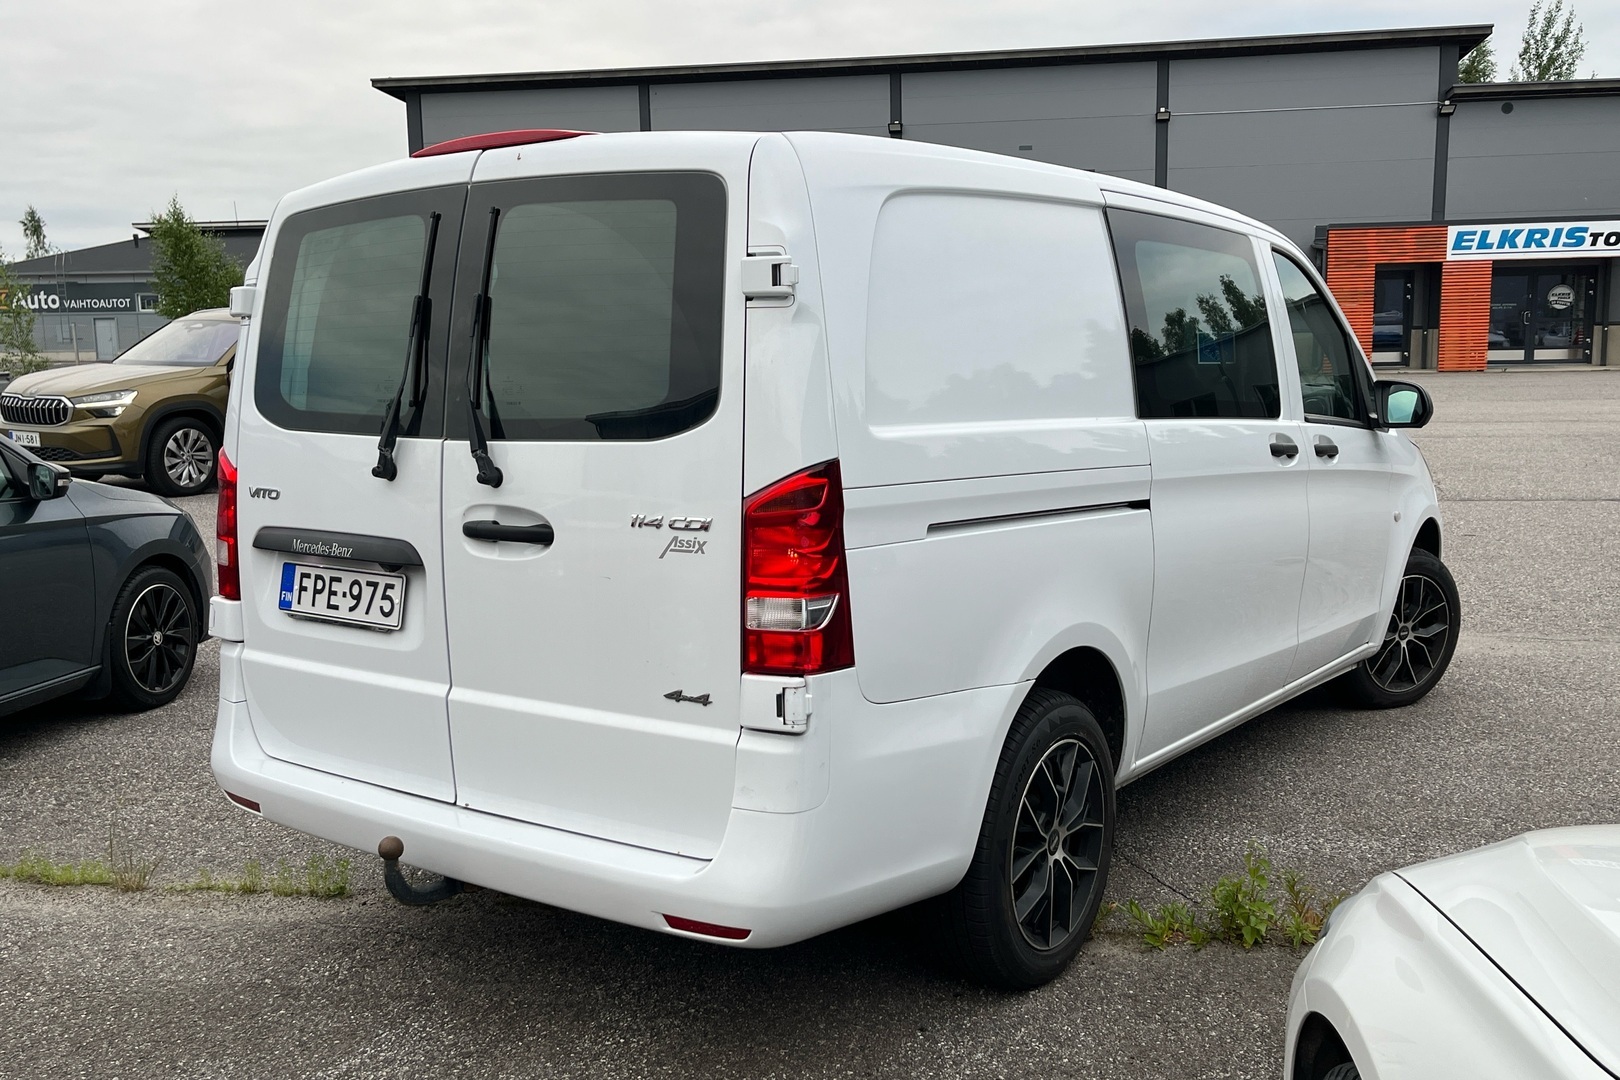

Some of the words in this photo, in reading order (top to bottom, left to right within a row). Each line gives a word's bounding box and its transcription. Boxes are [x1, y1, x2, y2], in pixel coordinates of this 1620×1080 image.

[1452, 227, 1589, 251] ELKRIS
[12, 290, 60, 309] Auto
[63, 298, 131, 309] VAIHTOAUTOT
[249, 487, 281, 500] VITO
[630, 514, 664, 529] 114
[668, 516, 713, 532] CDI
[291, 538, 353, 558] Mercedes-Benz
[281, 591, 293, 602] FIN
[297, 572, 396, 618] FPE-975
